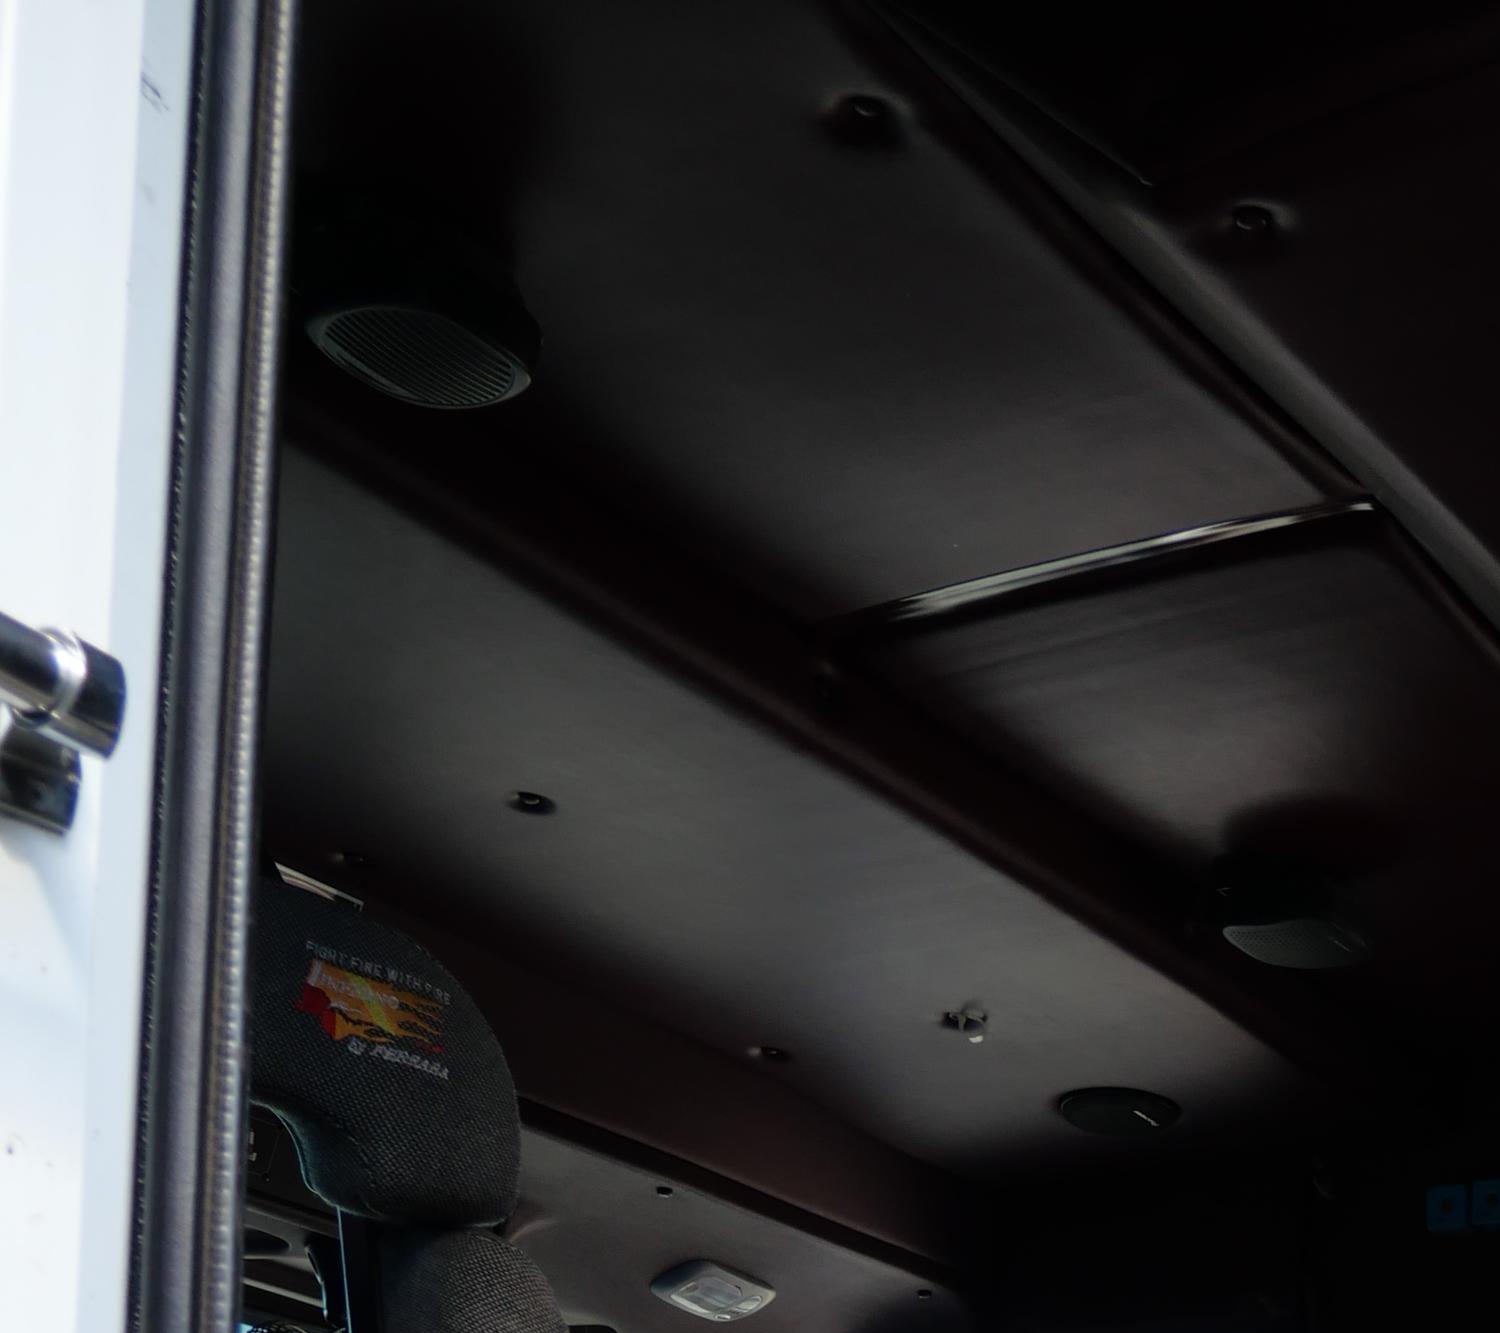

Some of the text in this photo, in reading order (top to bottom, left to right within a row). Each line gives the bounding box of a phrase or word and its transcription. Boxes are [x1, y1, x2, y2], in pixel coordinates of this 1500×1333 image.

[306, 942, 346, 962] FIGHT
[351, 957, 382, 977] FIRE
[386, 966, 419, 987] WITH
